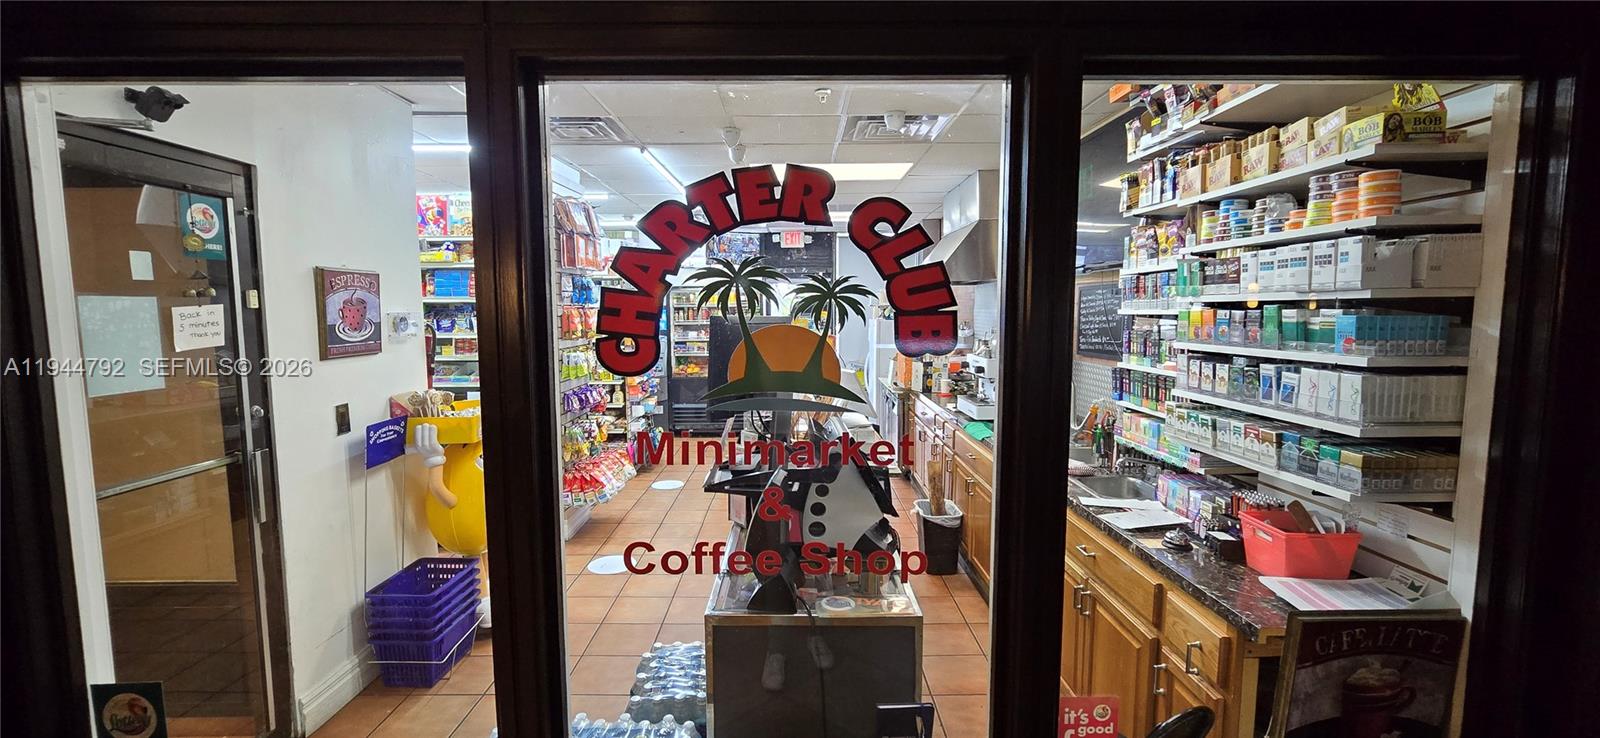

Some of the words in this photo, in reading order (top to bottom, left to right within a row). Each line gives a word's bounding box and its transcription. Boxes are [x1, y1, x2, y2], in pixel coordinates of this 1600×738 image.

[1358, 121, 1379, 134] BOB
[1413, 114, 1442, 126] BOB
[1242, 155, 1265, 175] RAW
[784, 232, 800, 245] EXIT
[595, 163, 836, 377] CHARTER
[847, 196, 958, 358] CLUB
[329, 273, 377, 292] ESPRESSO
[179, 311, 201, 321] Back
[206, 309, 216, 317] in
[179, 323, 185, 333] 5
[636, 432, 915, 467] Minimarket
[758, 486, 793, 522] &
[622, 541, 783, 576] Coffee
[800, 541, 929, 583] Shop
[1064, 707, 1089, 725] it's
[1078, 722, 1114, 738] good
